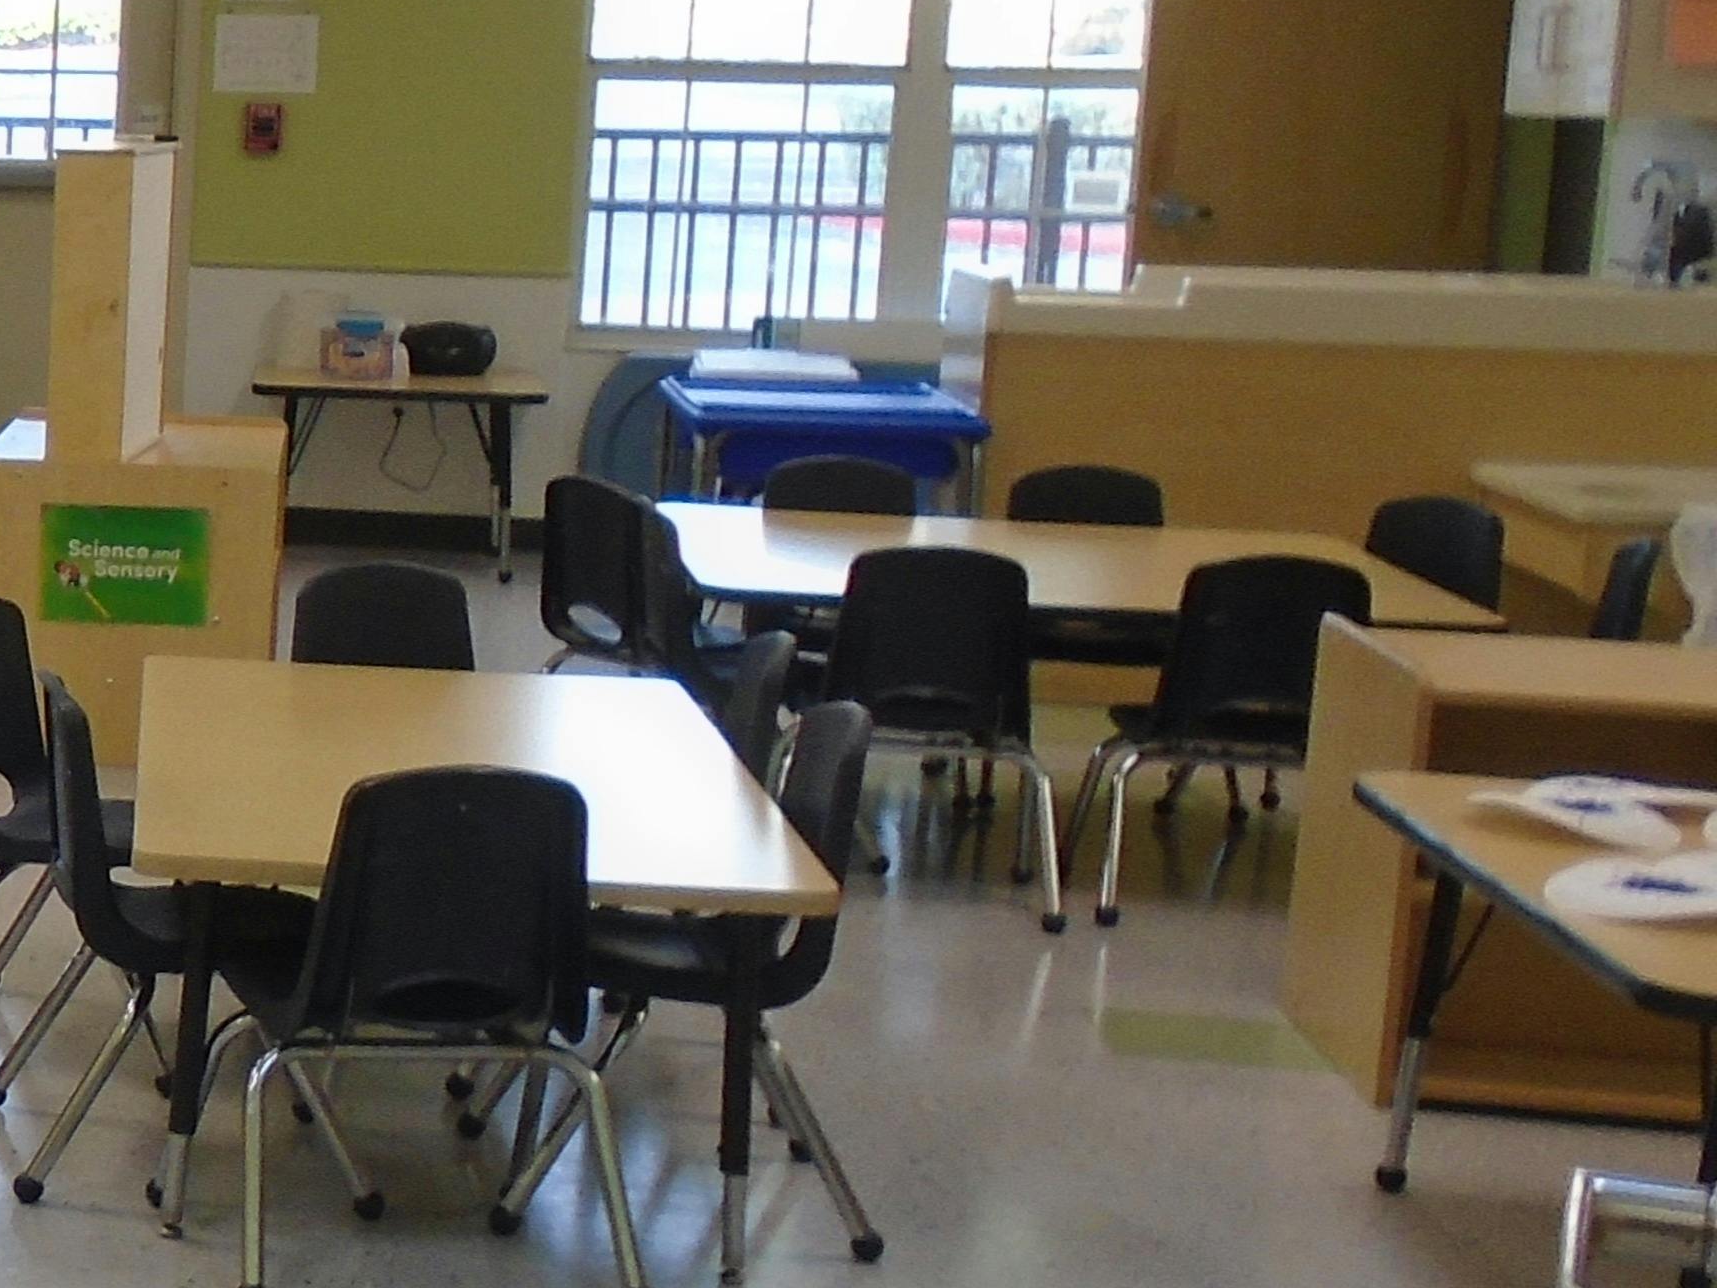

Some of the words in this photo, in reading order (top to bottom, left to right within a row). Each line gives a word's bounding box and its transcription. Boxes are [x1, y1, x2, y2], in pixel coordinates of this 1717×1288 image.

[68, 538, 149, 560] Science
[151, 547, 181, 560] and
[94, 559, 179, 584] Sensory
